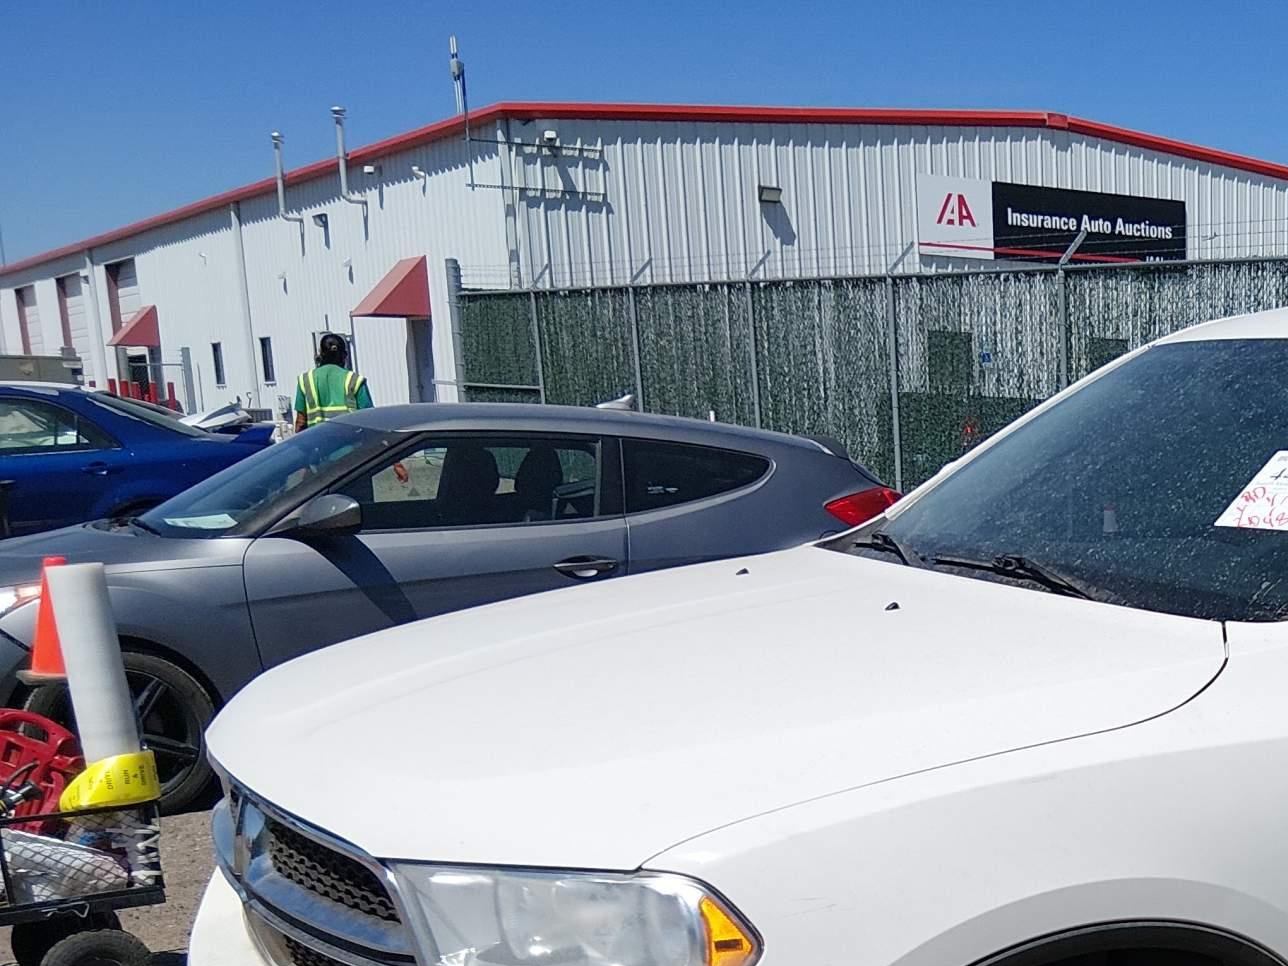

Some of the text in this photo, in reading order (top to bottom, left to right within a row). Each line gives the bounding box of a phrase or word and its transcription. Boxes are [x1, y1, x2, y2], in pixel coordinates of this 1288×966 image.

[1007, 207, 1173, 239] Insurance Auto Auctions
